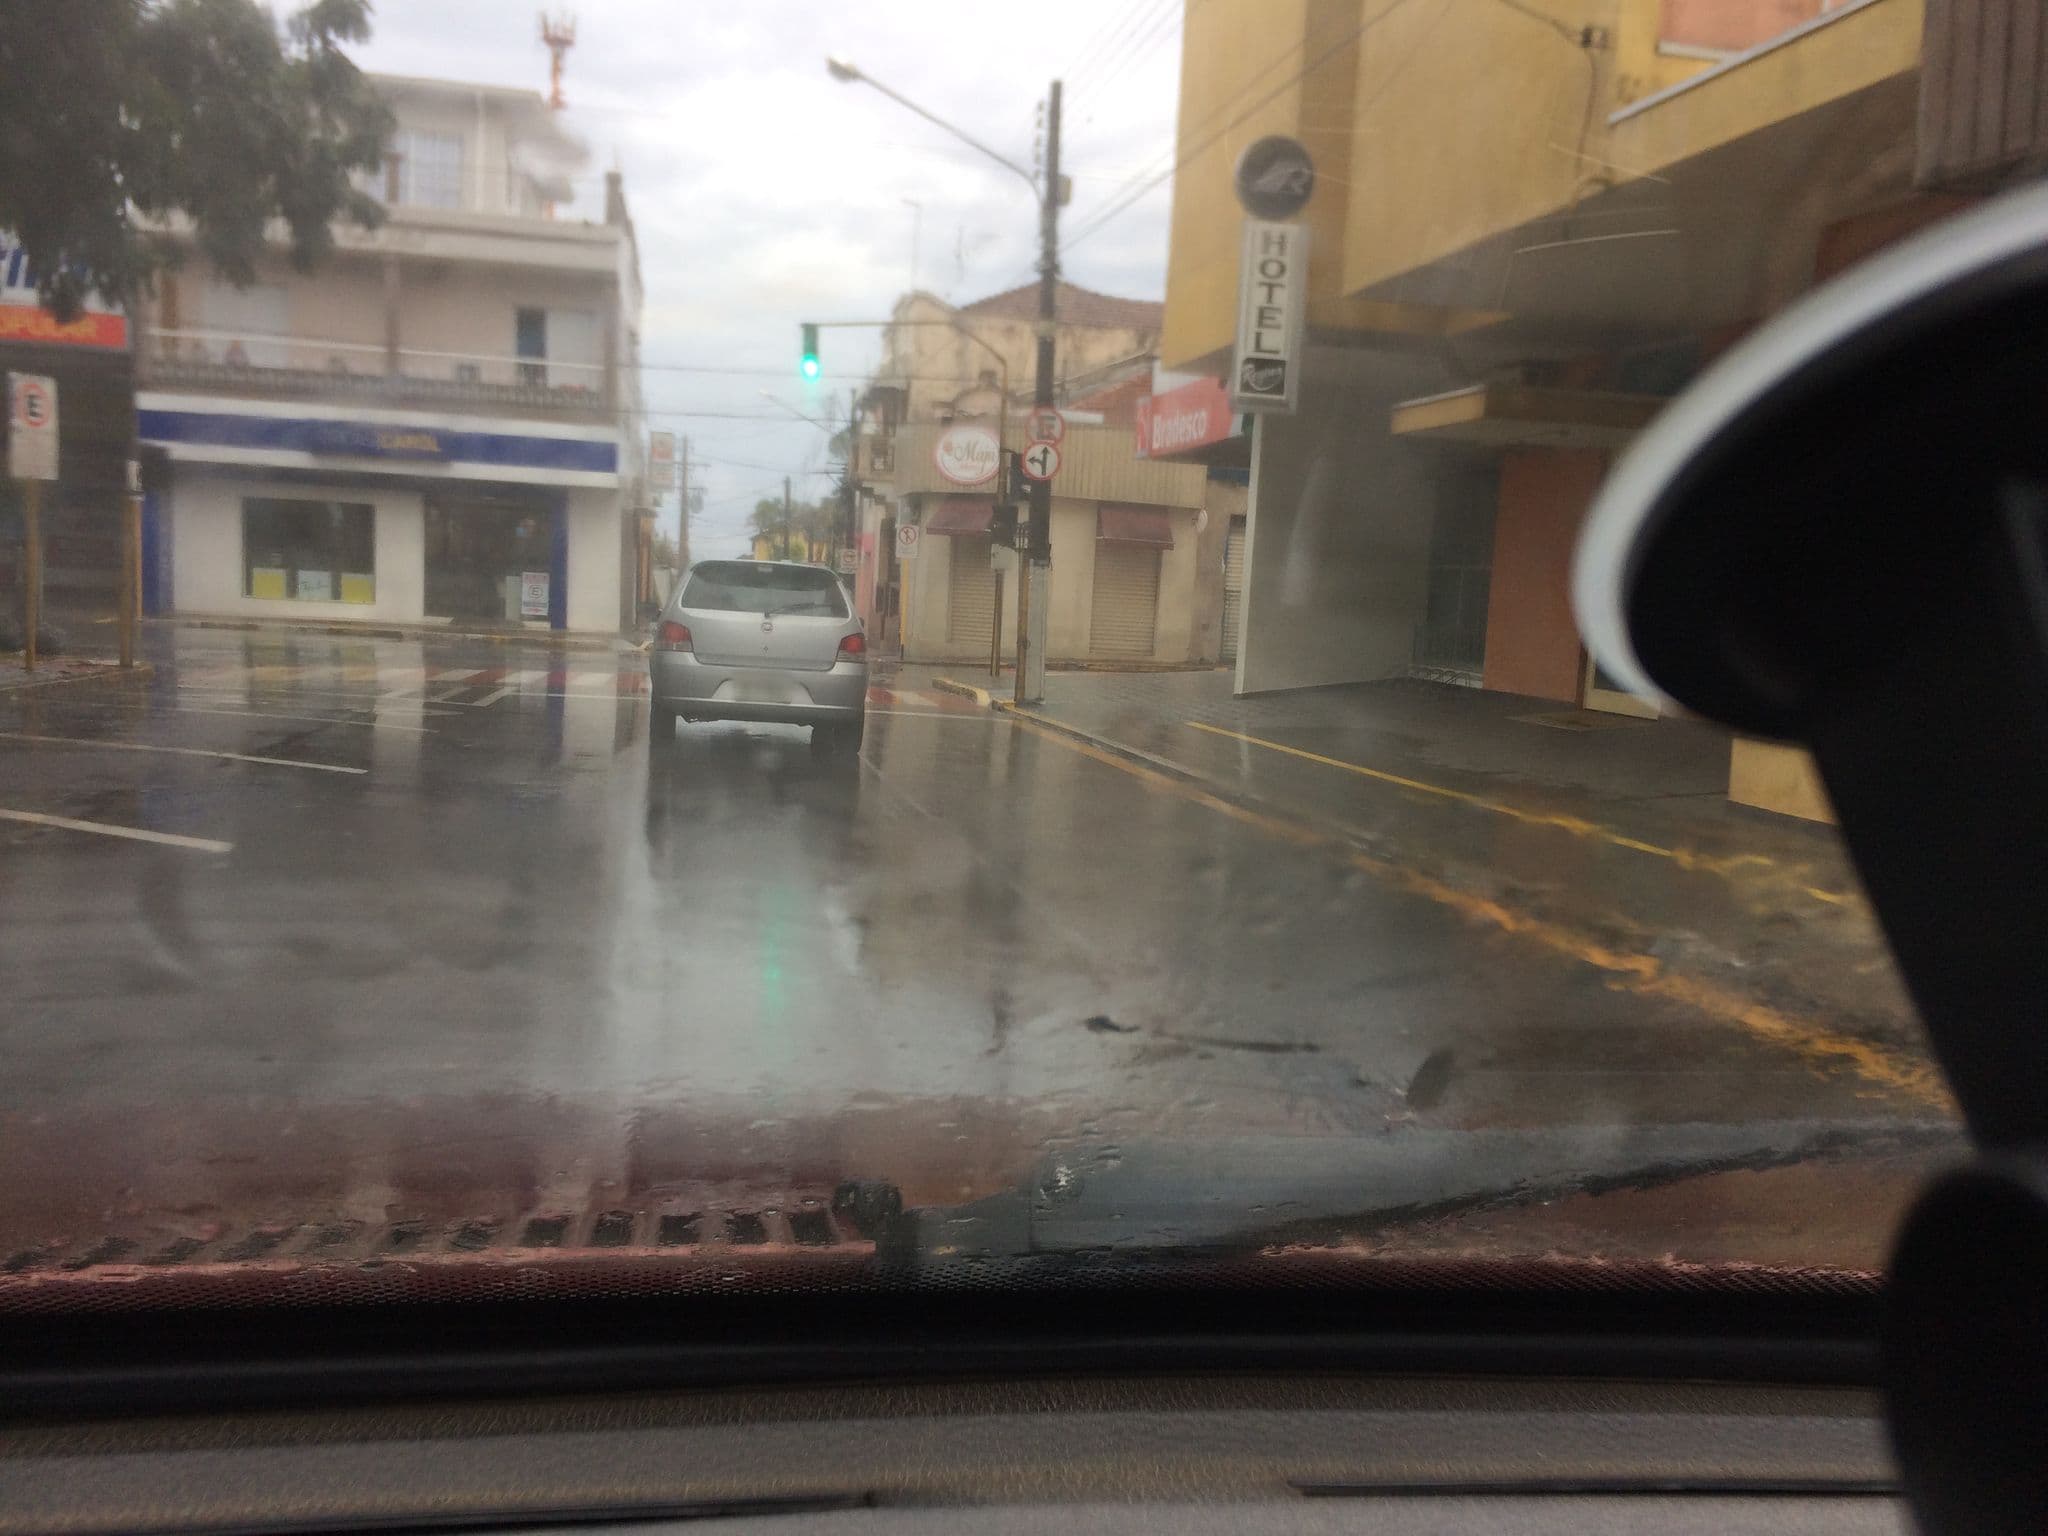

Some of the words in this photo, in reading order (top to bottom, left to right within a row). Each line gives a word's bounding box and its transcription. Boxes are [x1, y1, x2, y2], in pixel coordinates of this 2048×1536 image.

[1255, 231, 1287, 355] HOTEL
[26, 394, 42, 417] E
[1152, 408, 1207, 449] Bradesco
